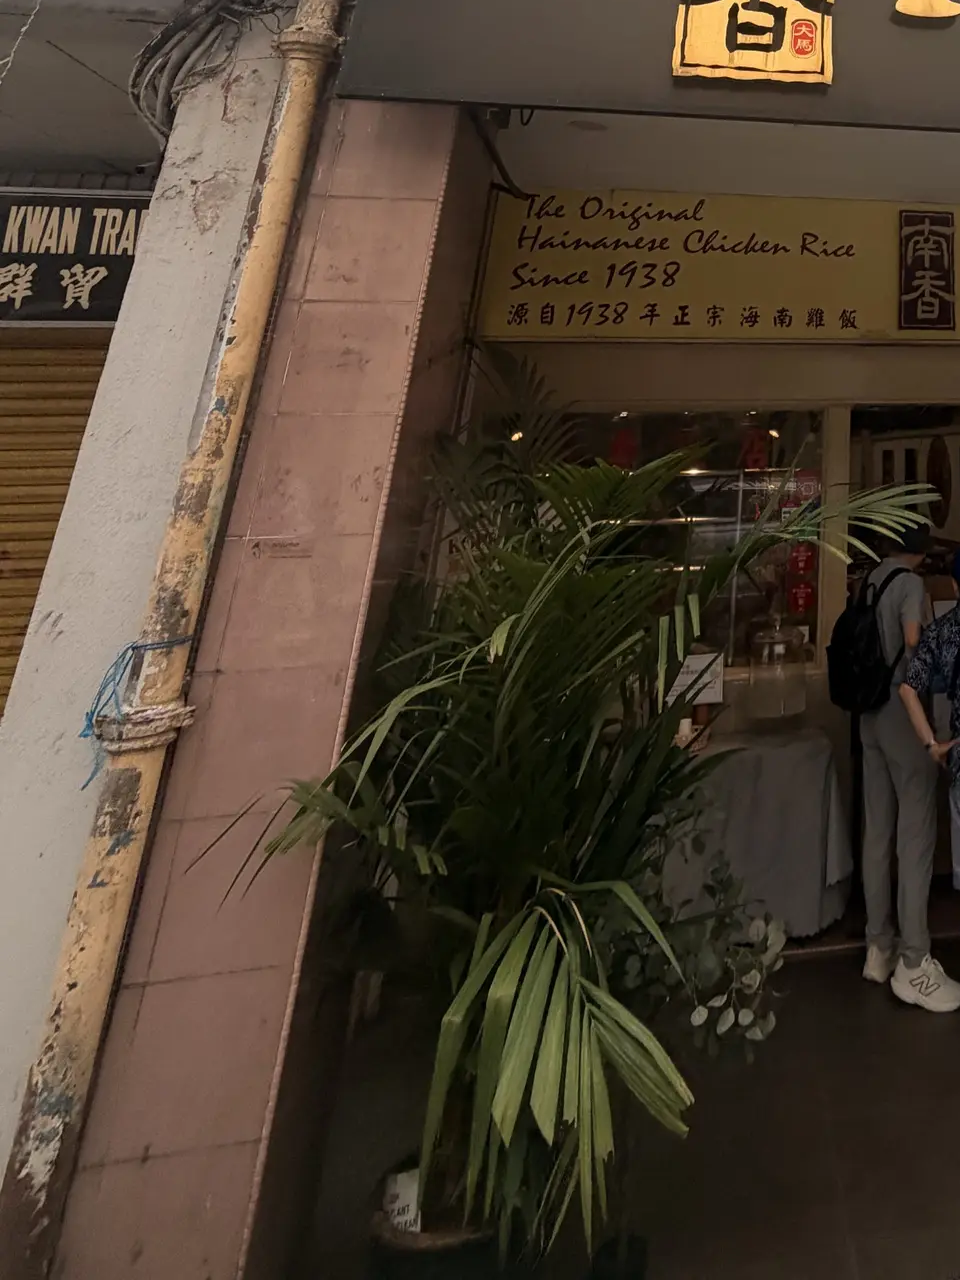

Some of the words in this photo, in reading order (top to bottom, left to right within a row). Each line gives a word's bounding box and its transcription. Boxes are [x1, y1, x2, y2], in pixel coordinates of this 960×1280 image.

[2, 205, 82, 254] KWAN
[524, 194, 567, 219] The
[579, 196, 706, 231] Original
[517, 224, 671, 253] Hainanese
[683, 229, 791, 255] Chicken
[800, 232, 856, 257] Rice
[509, 261, 591, 291] Since
[605, 260, 681, 290] 1938
